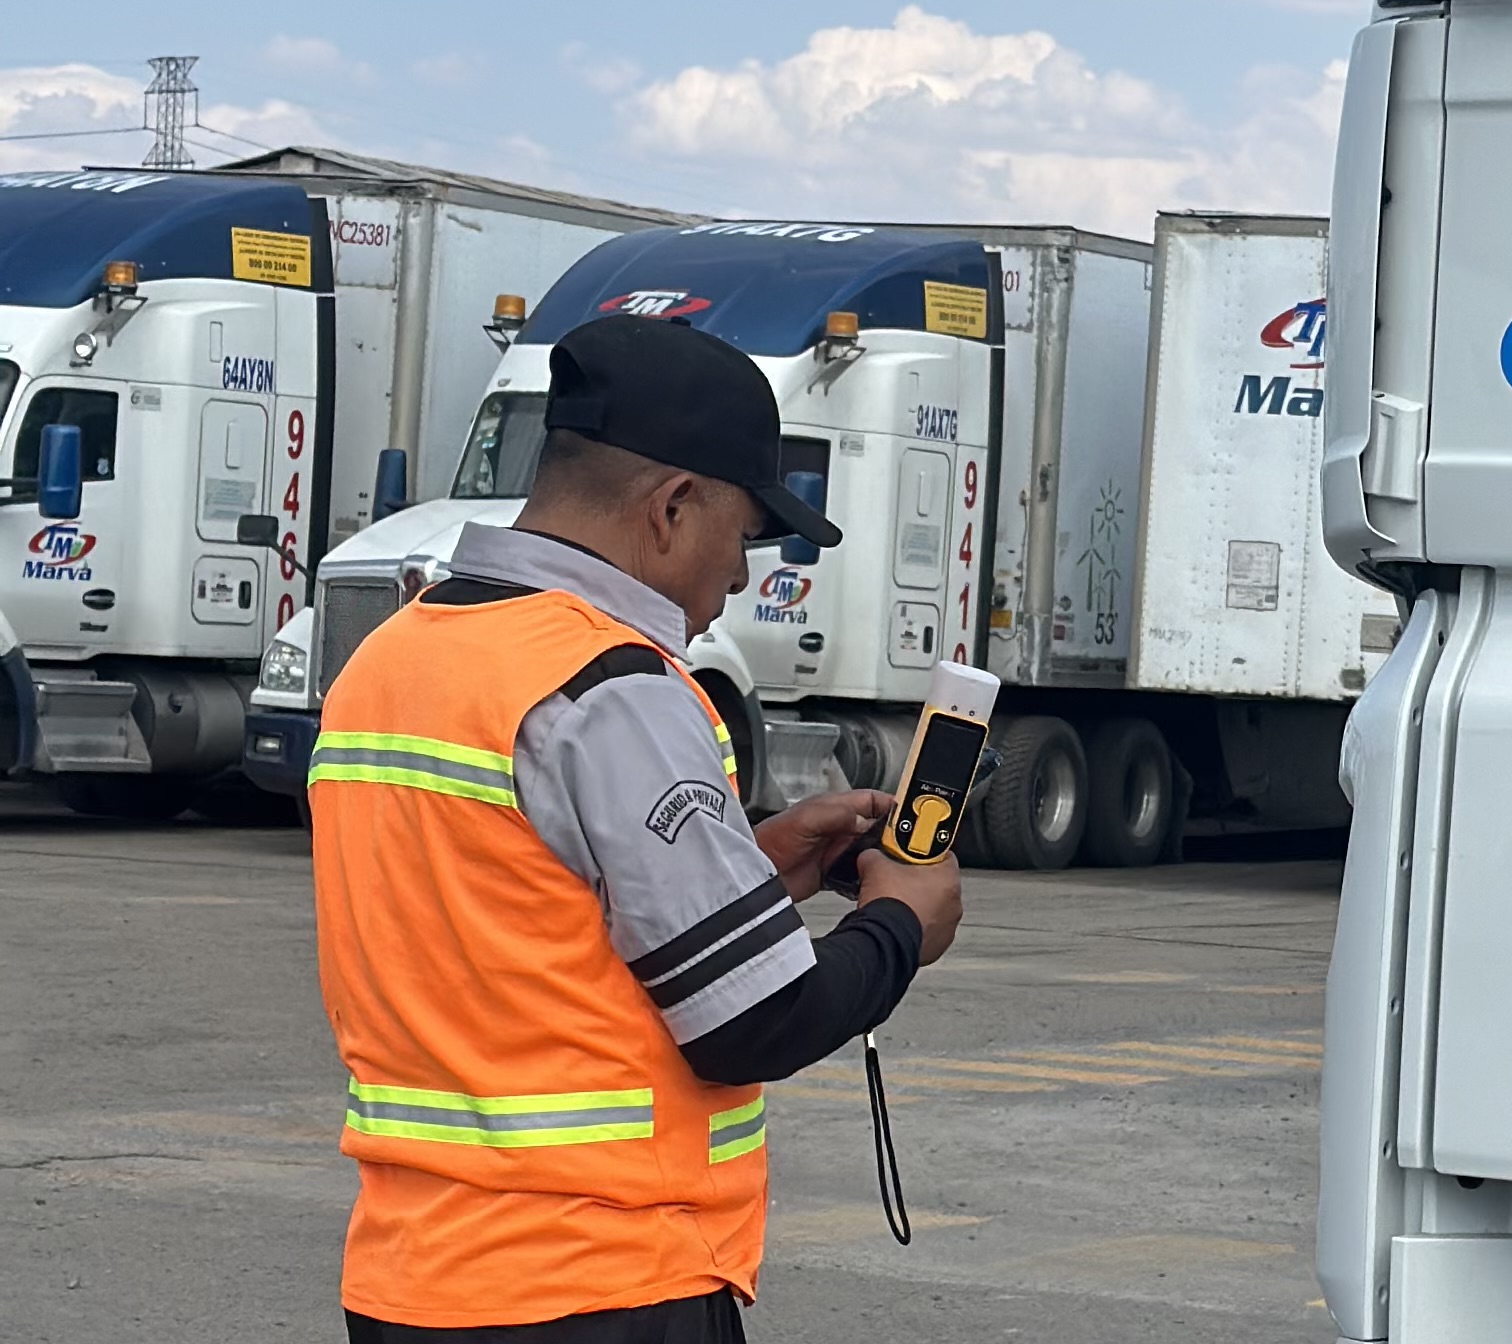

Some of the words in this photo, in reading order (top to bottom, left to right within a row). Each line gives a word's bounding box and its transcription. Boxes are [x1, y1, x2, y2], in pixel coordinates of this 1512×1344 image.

[328, 220, 391, 247] VC25381
[223, 356, 274, 393] 64AY8N
[916, 404, 957, 441] 91AX7G
[23, 560, 92, 581] Marva
[753, 604, 808, 625] Marva
